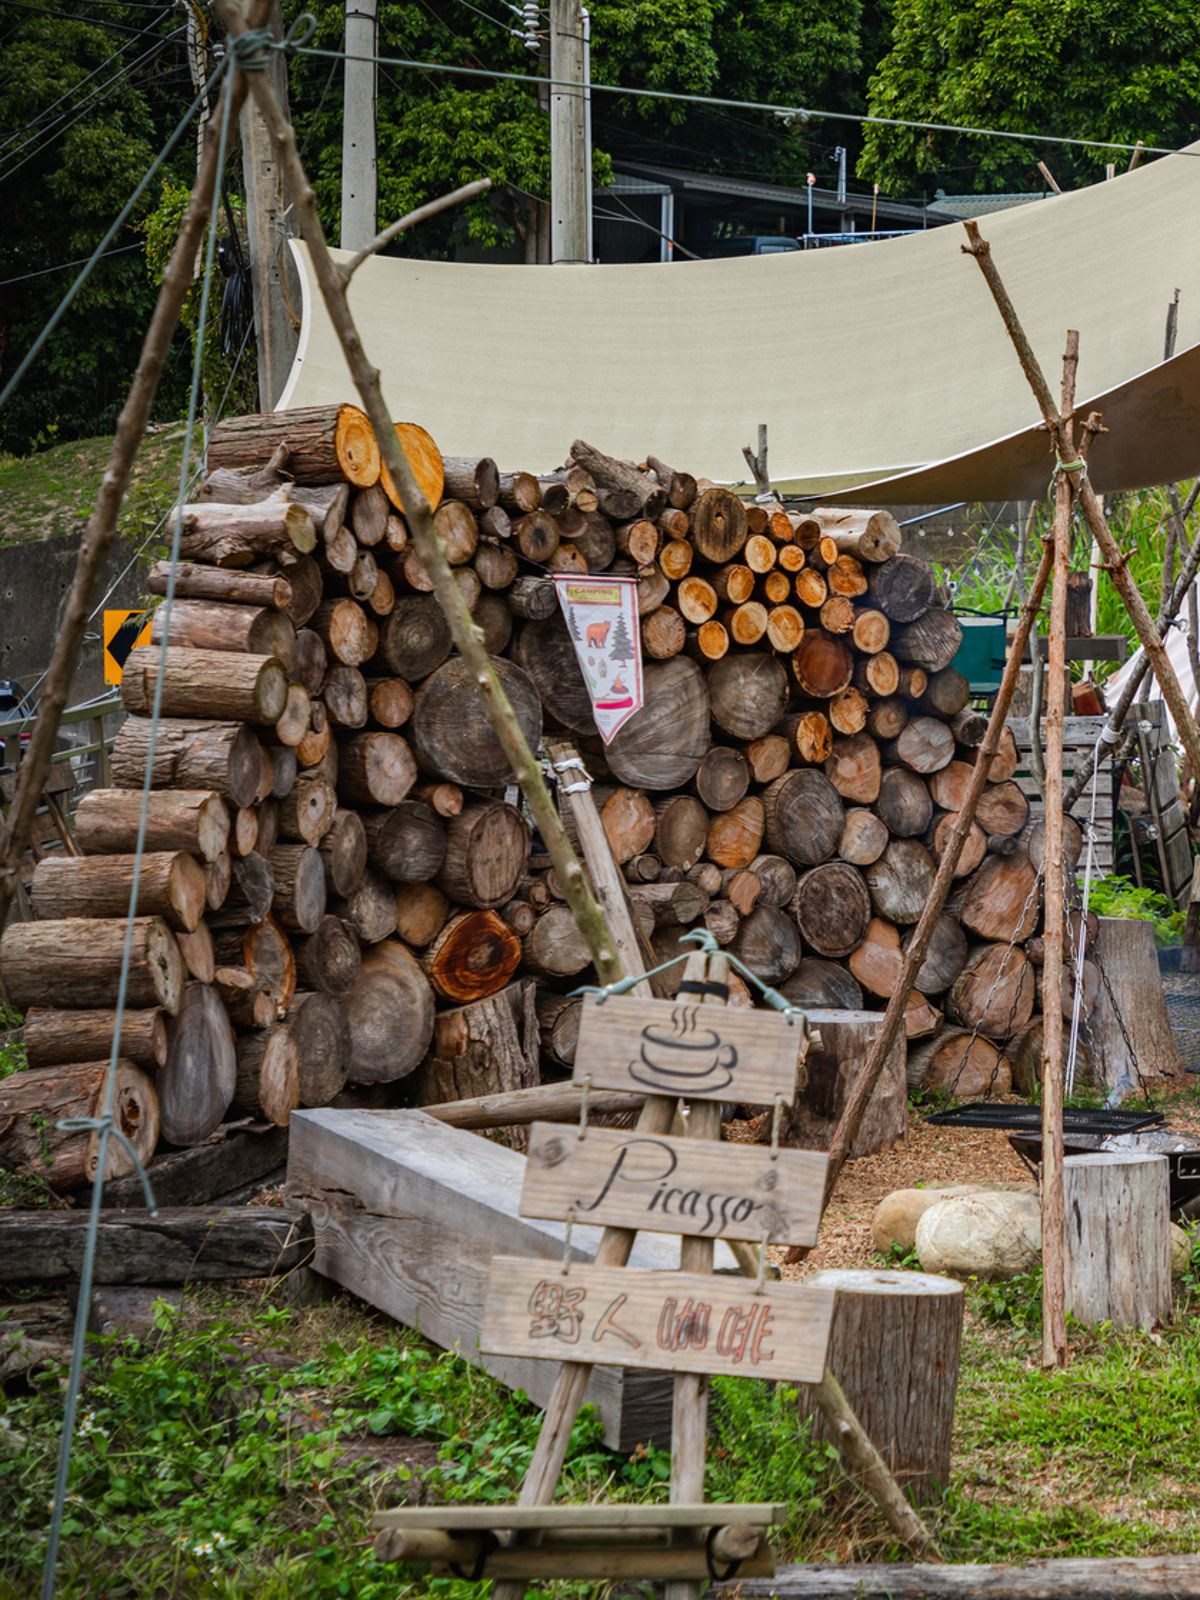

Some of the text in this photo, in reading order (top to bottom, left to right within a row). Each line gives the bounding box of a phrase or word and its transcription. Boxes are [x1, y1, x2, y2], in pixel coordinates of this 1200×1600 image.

[574, 587, 614, 595] CAMPING
[575, 1138, 764, 1234] Picasso
[527, 1279, 776, 1364] 野人咖啡
